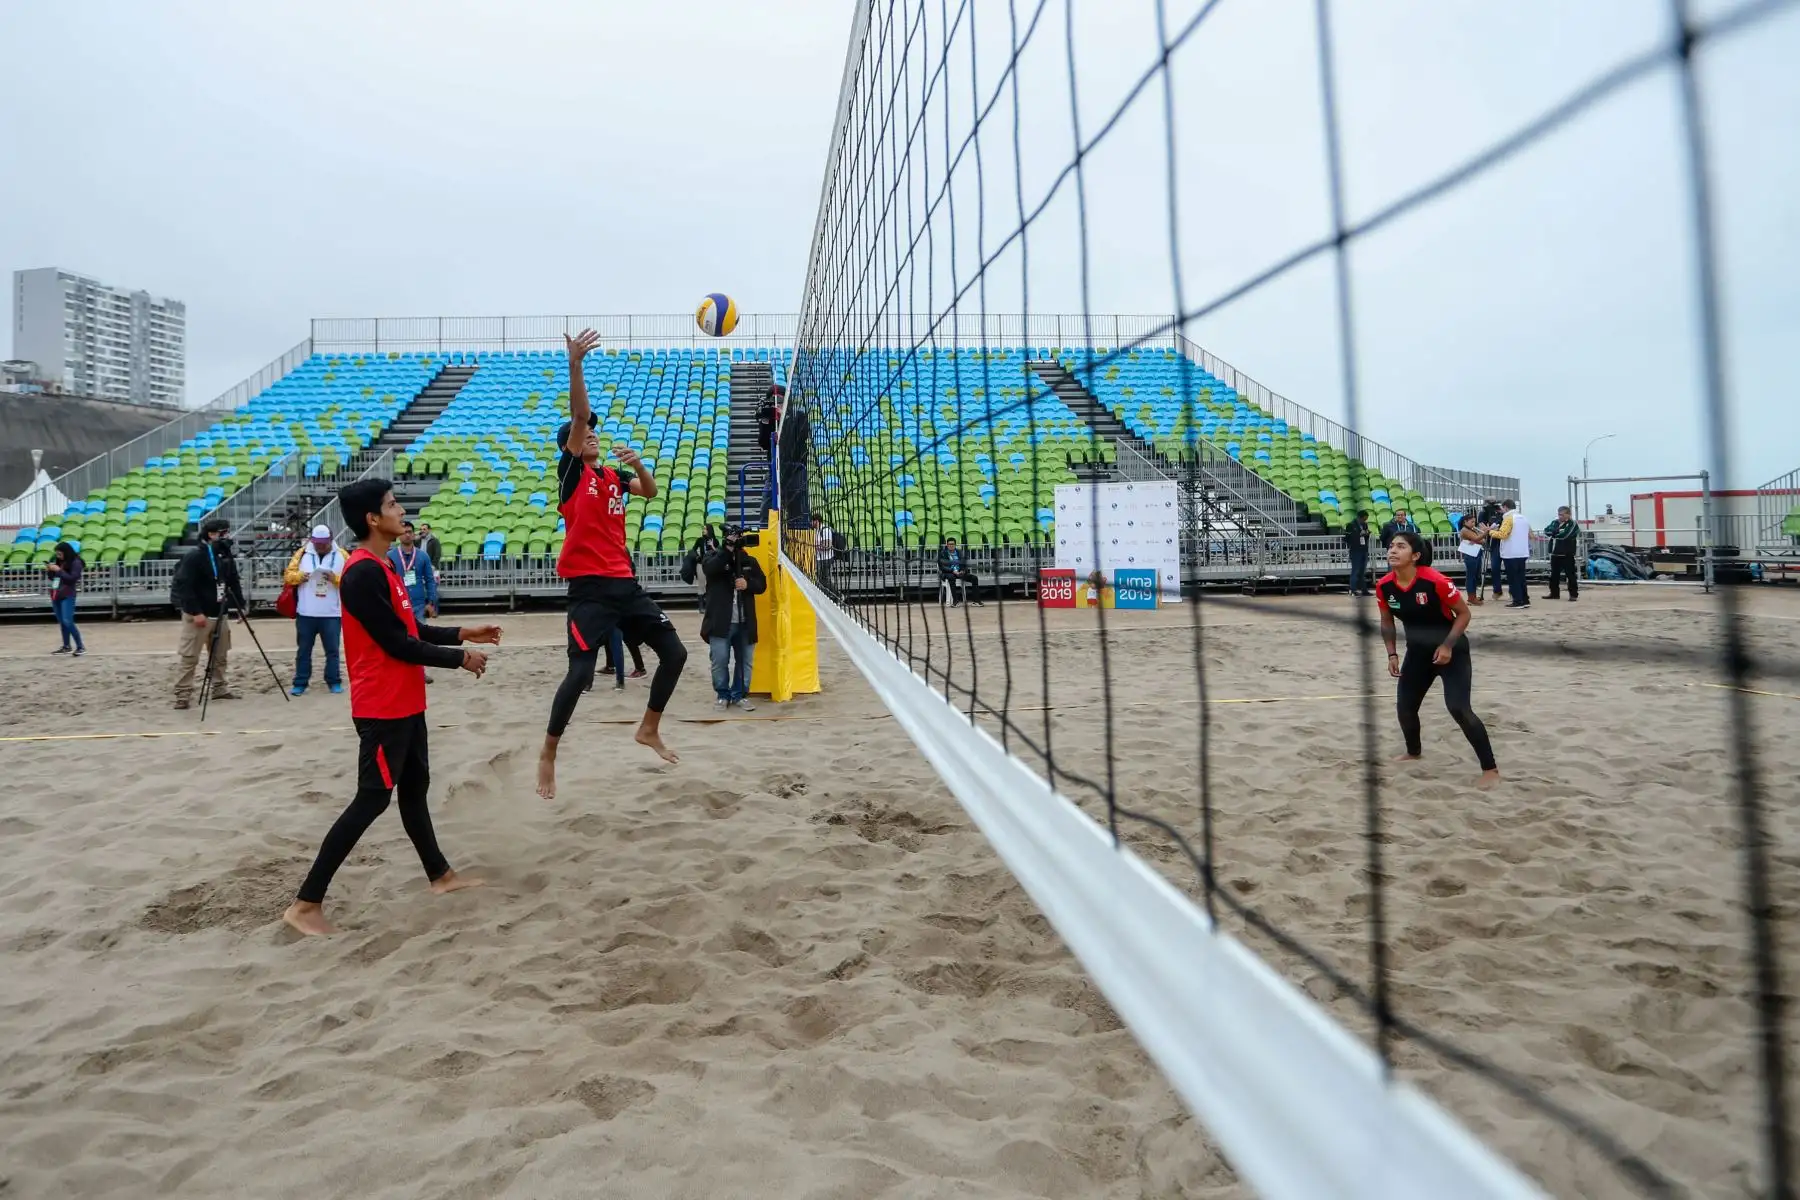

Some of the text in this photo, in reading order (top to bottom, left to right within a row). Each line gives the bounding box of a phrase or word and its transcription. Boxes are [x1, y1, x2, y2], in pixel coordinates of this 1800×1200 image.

[609, 484, 621, 498] 2
[1041, 588, 1072, 600] 2019
[1119, 588, 1152, 600] 2019
